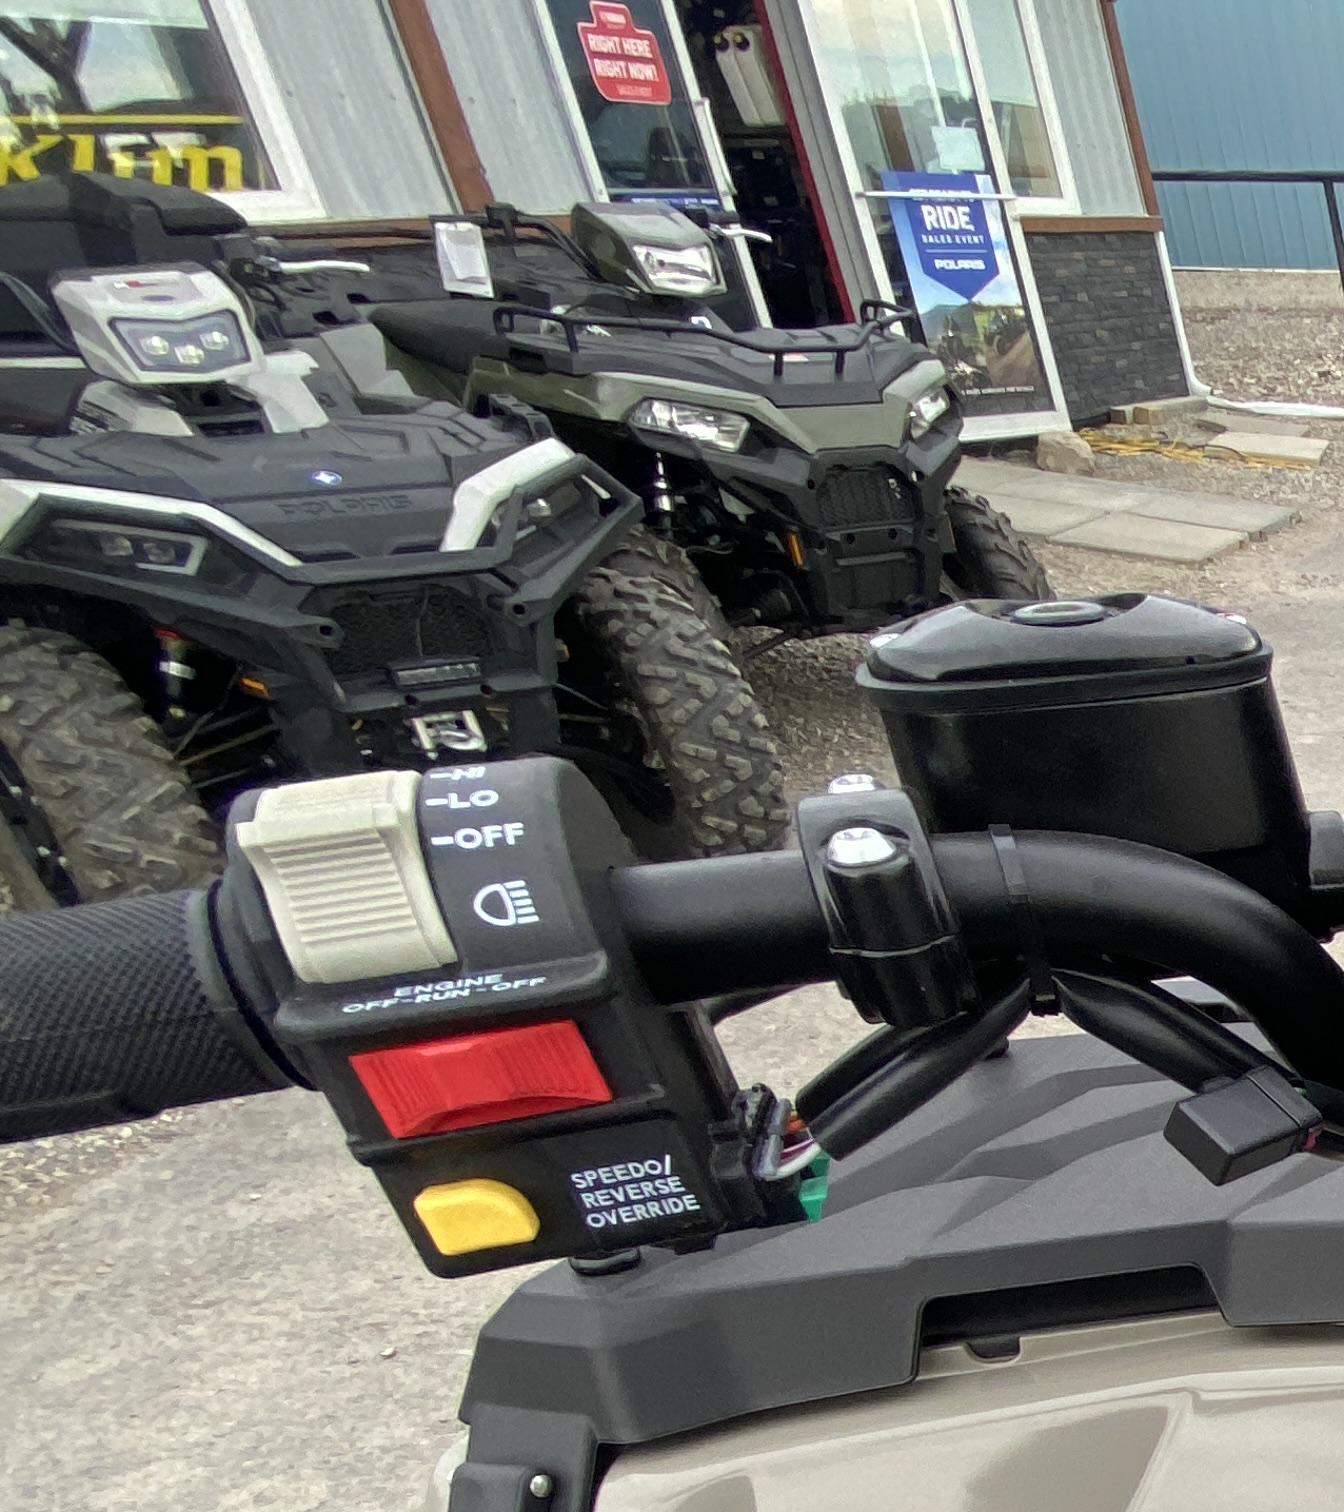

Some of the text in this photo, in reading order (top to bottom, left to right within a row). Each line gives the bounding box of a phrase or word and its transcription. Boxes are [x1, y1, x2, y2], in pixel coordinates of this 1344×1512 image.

[588, 34, 653, 58] RIGHT HERE
[593, 58, 660, 82] RIGHT NOW!
[921, 204, 975, 232] RIDE
[955, 235, 985, 245] EVENT
[934, 258, 986, 270] POLARIS
[455, 822, 525, 850] OFF
[393, 974, 503, 997] ENGINE
[571, 1155, 671, 1190] SPEEDO/
[582, 1177, 686, 1209] REVERSE
[587, 1194, 700, 1229] OVERRIDE
